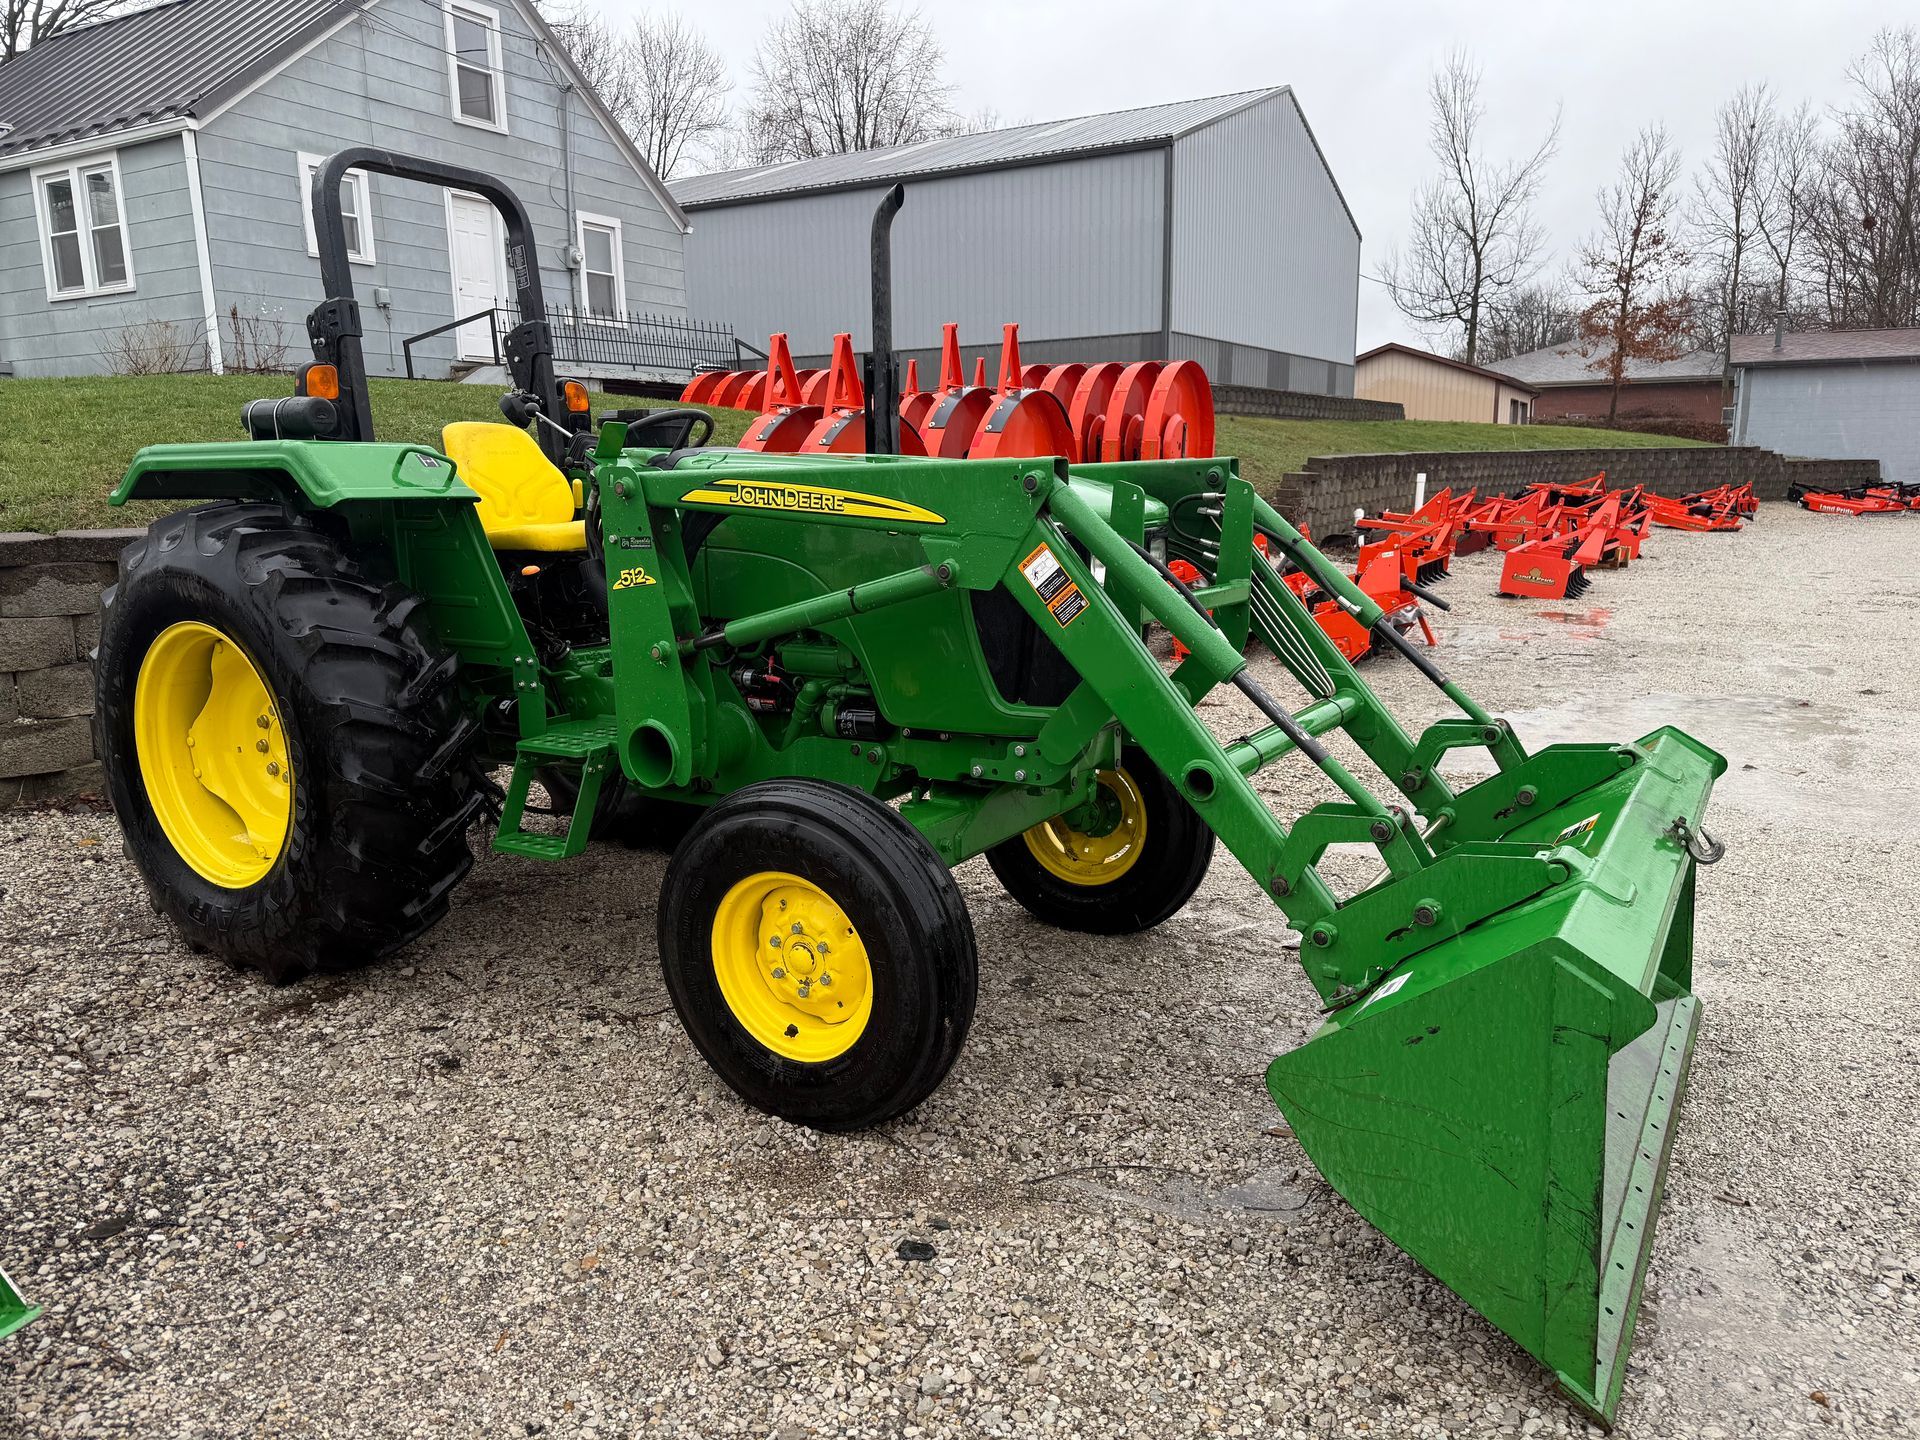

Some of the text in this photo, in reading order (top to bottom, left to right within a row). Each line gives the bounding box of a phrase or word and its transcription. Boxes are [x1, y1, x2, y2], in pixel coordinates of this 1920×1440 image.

[730, 483, 845, 511] JOHN DEERE
[1820, 504, 1835, 512] Land
[620, 567, 646, 586] 512
